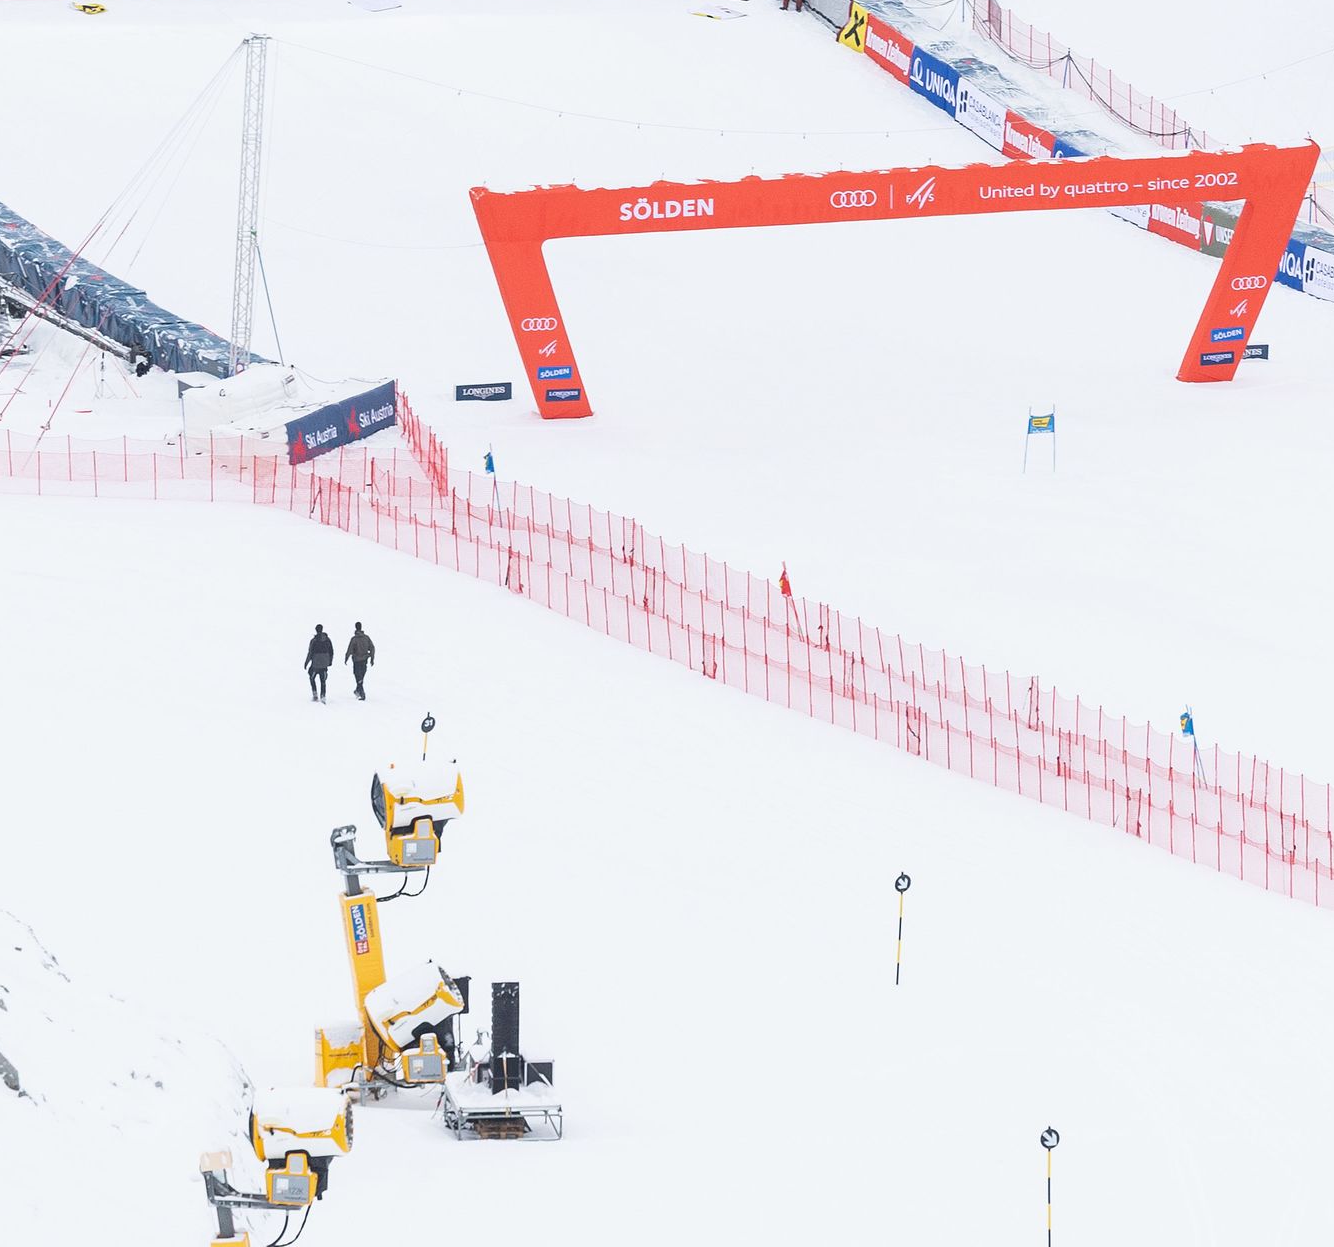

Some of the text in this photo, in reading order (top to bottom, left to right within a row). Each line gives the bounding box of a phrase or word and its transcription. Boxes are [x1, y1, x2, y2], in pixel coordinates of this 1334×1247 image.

[925, 68, 956, 108] UNIQA
[978, 183, 1035, 201] United
[1039, 182, 1062, 202] by
[1064, 178, 1129, 201] quattro
[1147, 174, 1191, 192] since
[1194, 171, 1239, 189] 2002
[619, 197, 715, 221] SÖLDEN
[1213, 328, 1242, 341] SÖLDEN
[539, 367, 570, 379] SÖLDEN
[462, 386, 506, 396] LONGINES
[358, 402, 394, 428] Ski Austria
[305, 424, 338, 449] Ski Austria
[423, 719, 434, 729] 31
[351, 904, 368, 941] SÖLDEN
